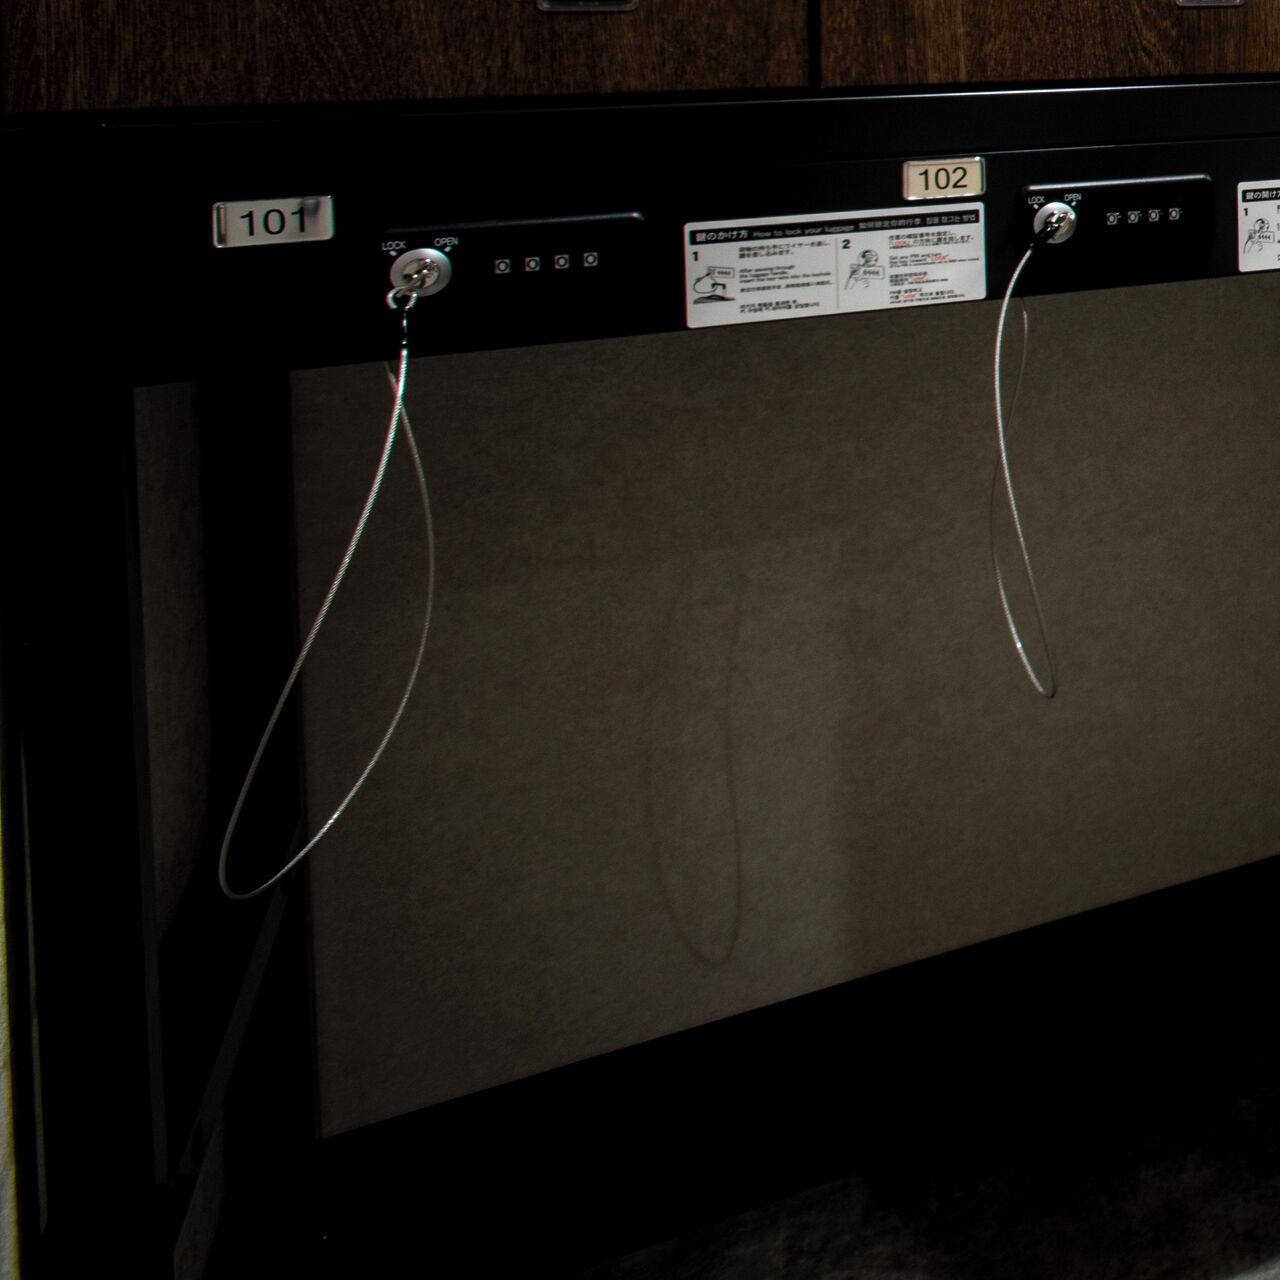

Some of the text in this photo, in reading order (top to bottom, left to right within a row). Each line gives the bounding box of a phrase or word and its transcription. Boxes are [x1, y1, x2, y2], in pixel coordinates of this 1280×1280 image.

[918, 166, 968, 191] 102
[1028, 196, 1045, 205] LOCK
[1064, 192, 1082, 201] OPEN
[1244, 208, 1248, 216] 1
[240, 206, 307, 237] 101
[382, 241, 406, 250] LOCK
[434, 237, 458, 246] OPEN
[842, 239, 850, 249] 2
[693, 251, 698, 262] 1
